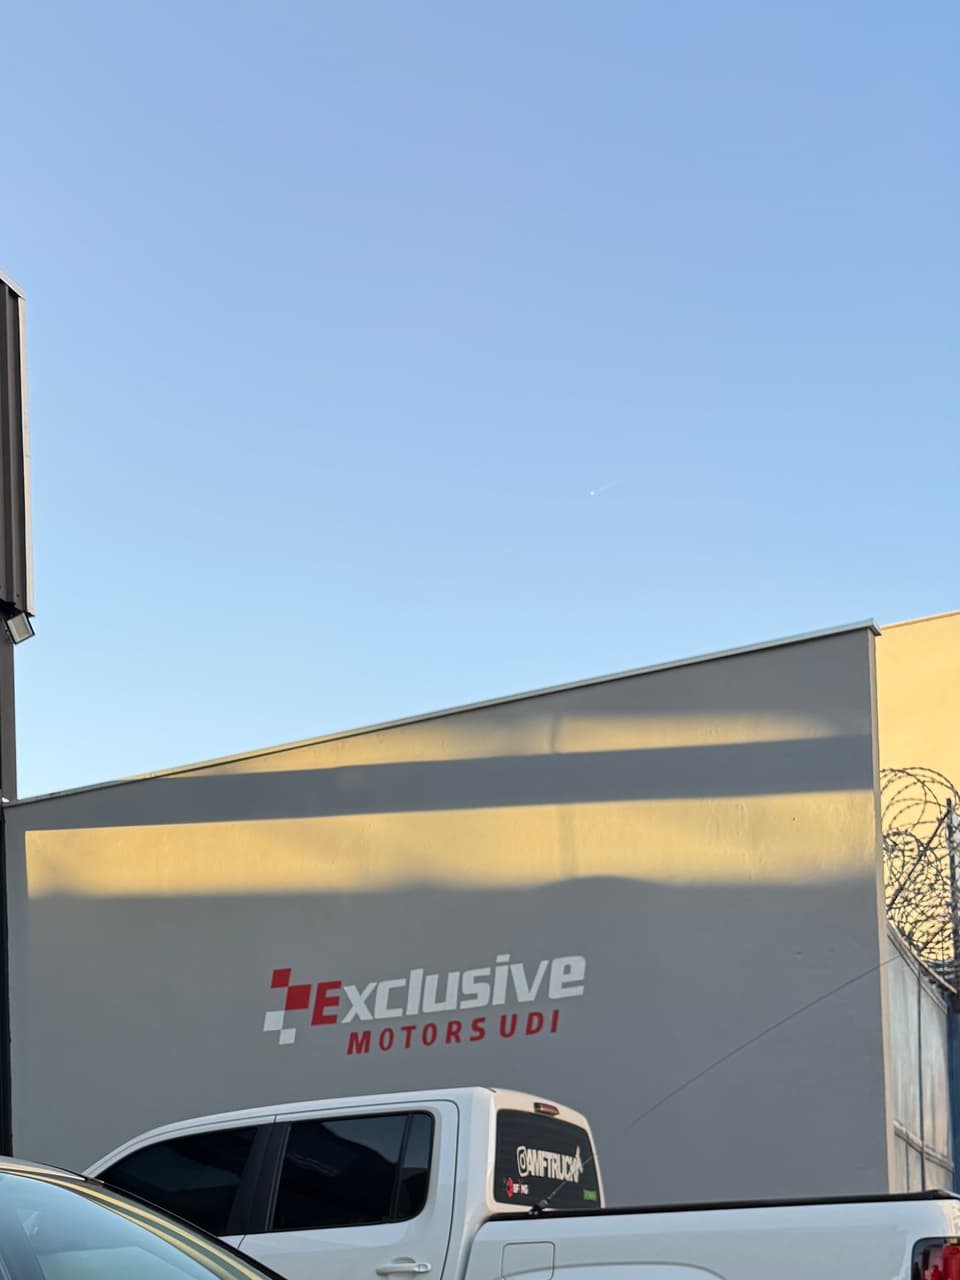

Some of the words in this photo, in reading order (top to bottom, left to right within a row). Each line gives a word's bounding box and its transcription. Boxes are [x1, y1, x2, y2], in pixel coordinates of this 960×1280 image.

[311, 953, 587, 1027] Exclusive
[346, 1017, 487, 1056] MOTORS
[499, 1009, 560, 1039] UDI
